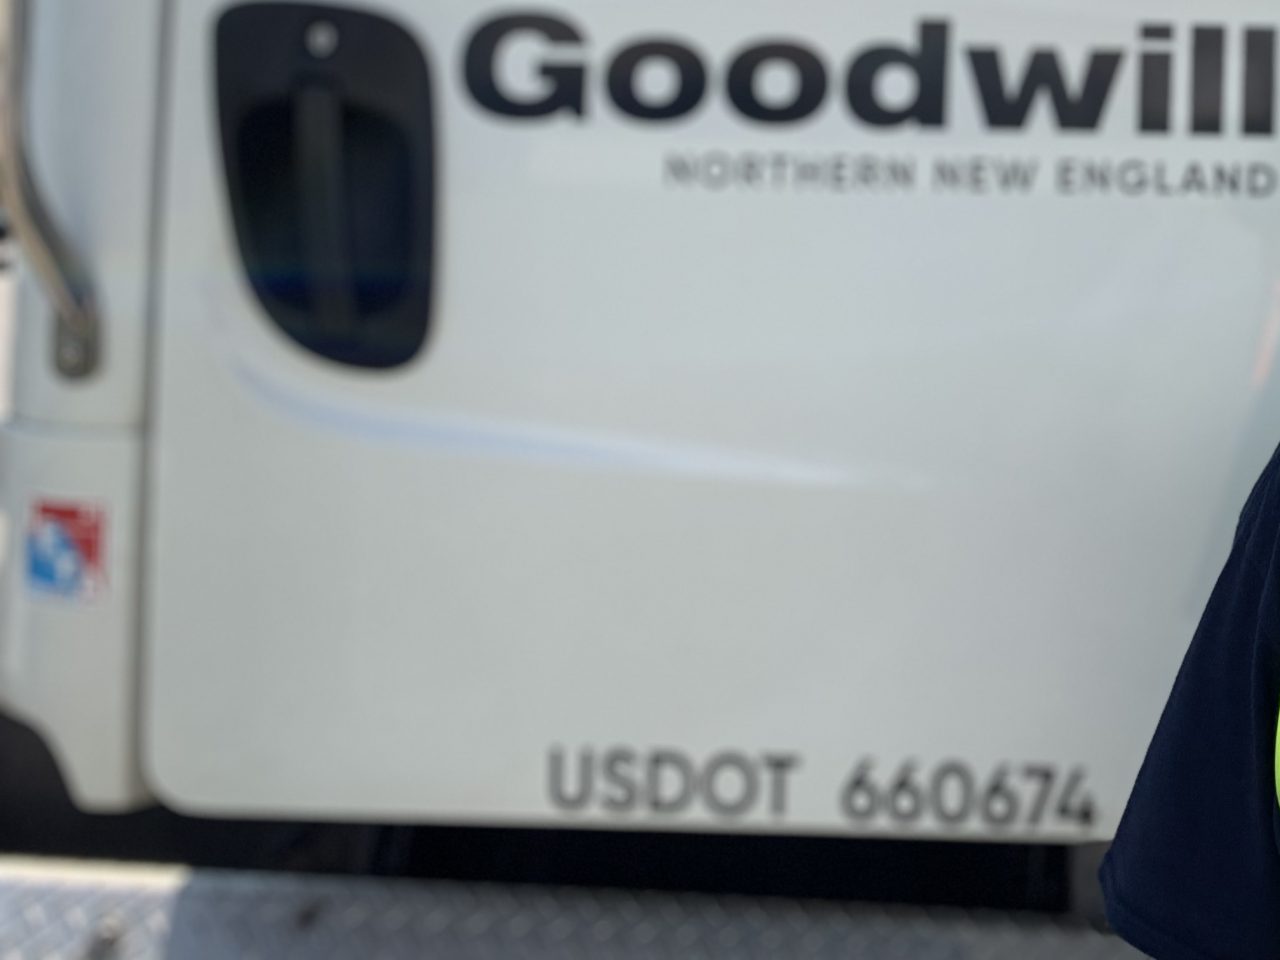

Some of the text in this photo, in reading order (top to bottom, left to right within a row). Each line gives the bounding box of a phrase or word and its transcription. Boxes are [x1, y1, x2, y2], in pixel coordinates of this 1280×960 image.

[462, 7, 1276, 136] Goodwill
[663, 151, 1278, 199] NORTHERN NEW ENGLAND
[546, 744, 1097, 828] USDOT 660674
